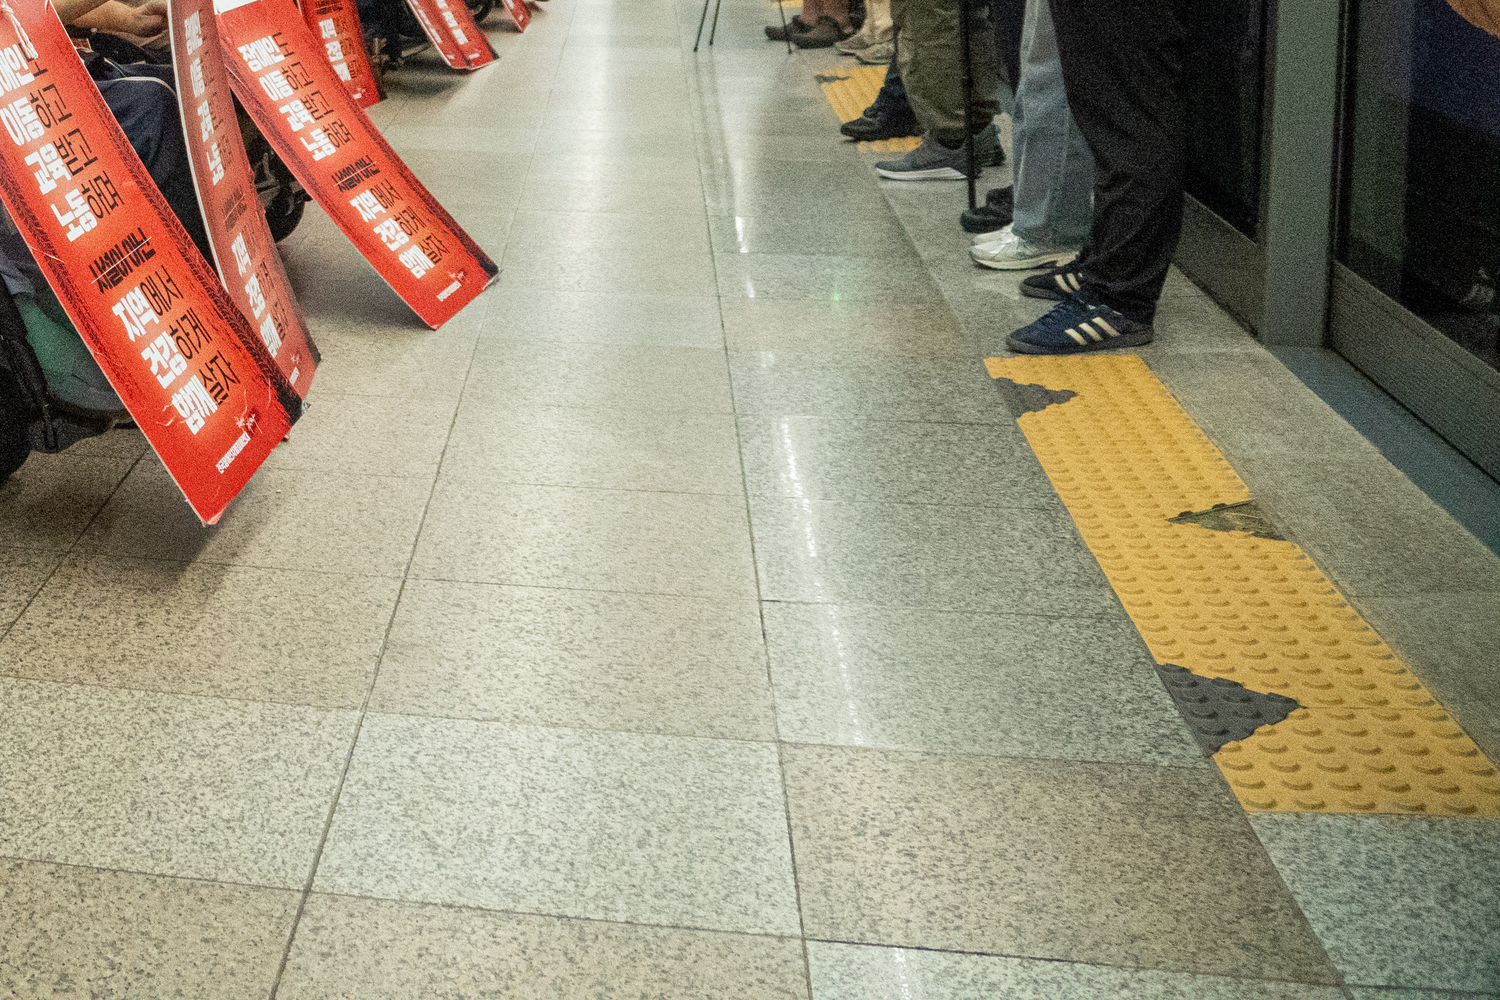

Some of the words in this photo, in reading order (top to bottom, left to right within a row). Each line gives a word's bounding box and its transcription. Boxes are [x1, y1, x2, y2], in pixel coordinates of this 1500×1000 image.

[237, 31, 295, 72] 장애인도
[259, 61, 314, 102] 이동하고
[0, 83, 73, 147] 이동하고
[279, 91, 334, 132] 교육받고
[24, 128, 99, 195] 교육받고
[300, 118, 354, 162] 노동하며
[50, 170, 125, 242] 노동하며
[350, 178, 403, 223] 지역에서
[373, 205, 427, 251] 건강하게
[111, 264, 184, 343] 지역에서
[141, 306, 213, 390] 건강하게
